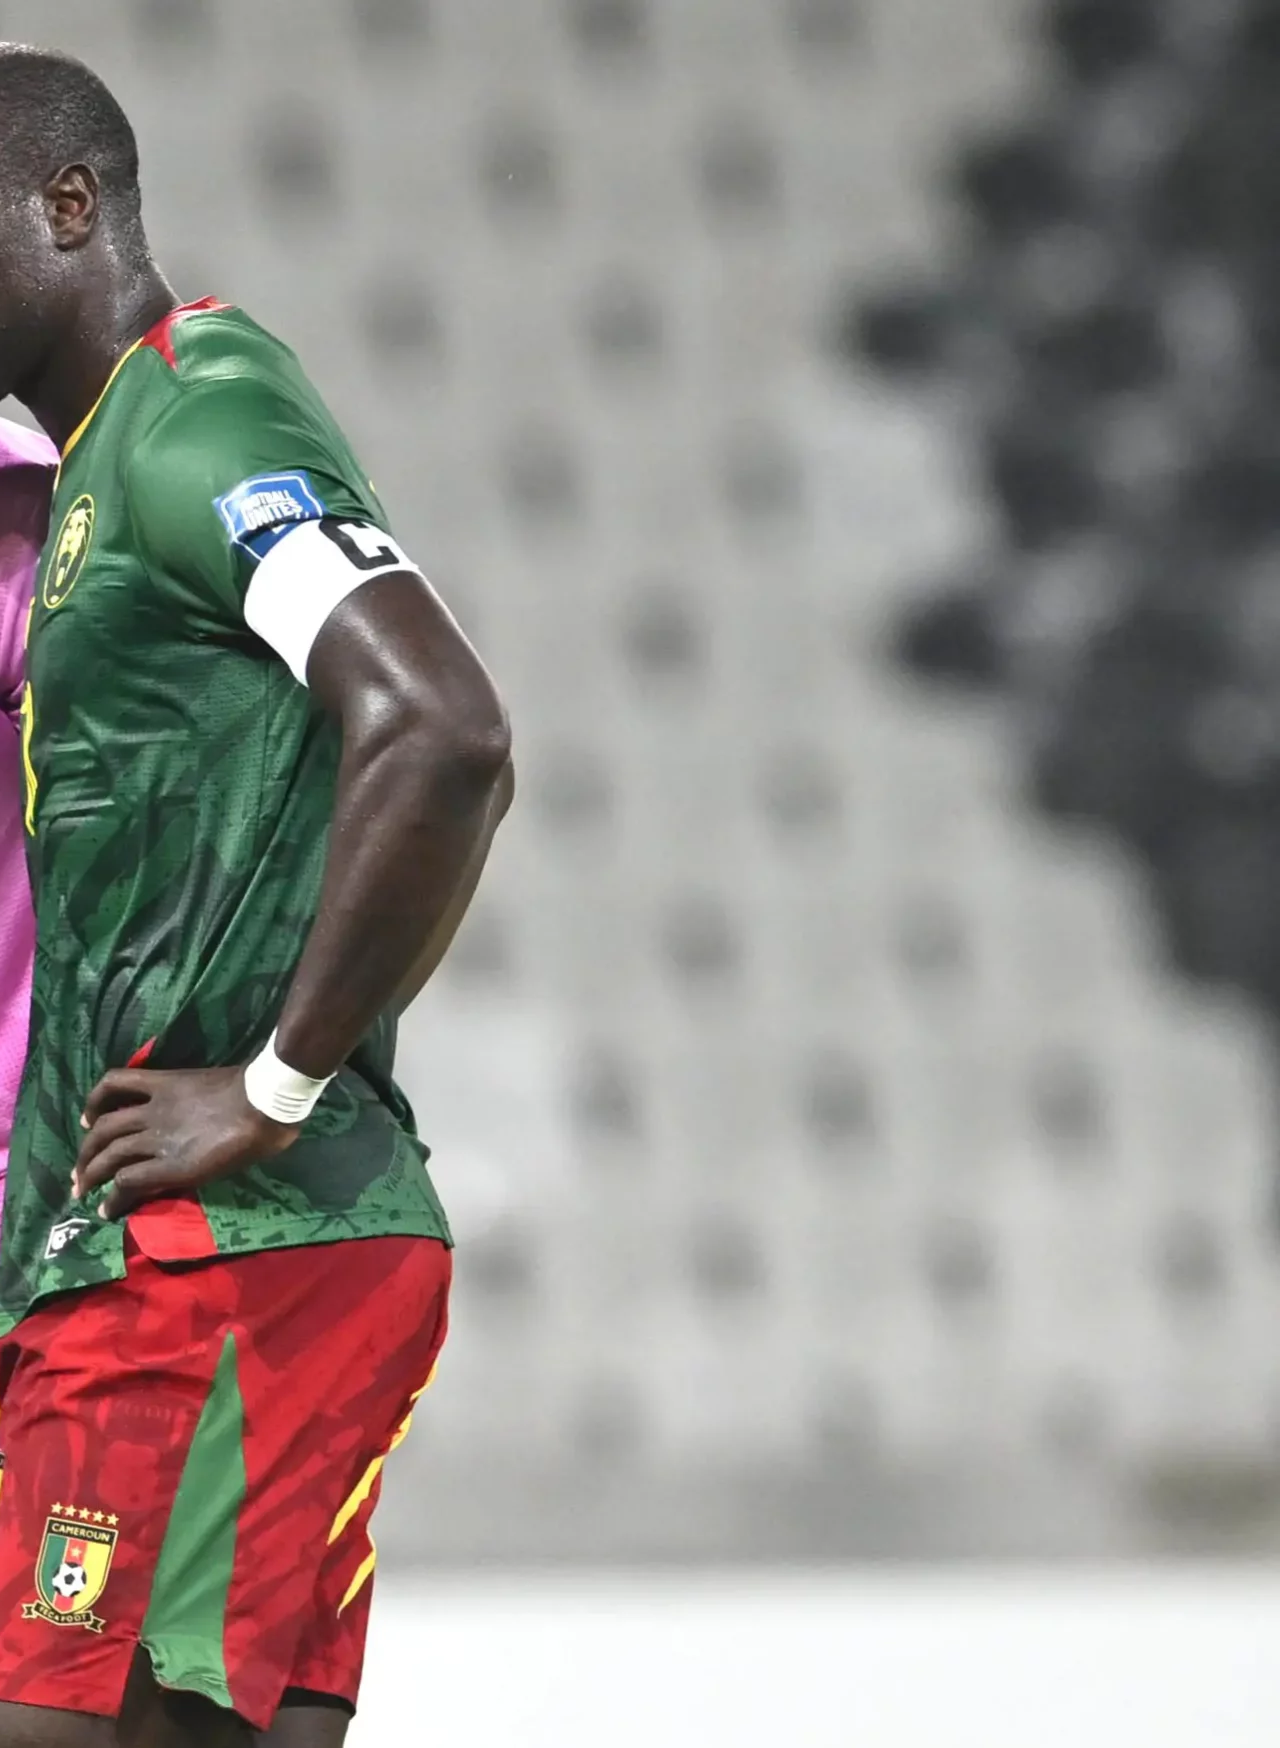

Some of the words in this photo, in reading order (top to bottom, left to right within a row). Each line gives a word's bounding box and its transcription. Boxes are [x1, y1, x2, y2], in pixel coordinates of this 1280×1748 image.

[240, 489, 294, 509] OTBALL
[241, 499, 304, 531] UNITES
[318, 518, 400, 571] C
[51, 1522, 111, 1543] CAMEROUN
[38, 1605, 87, 1622] FECAFOOT
